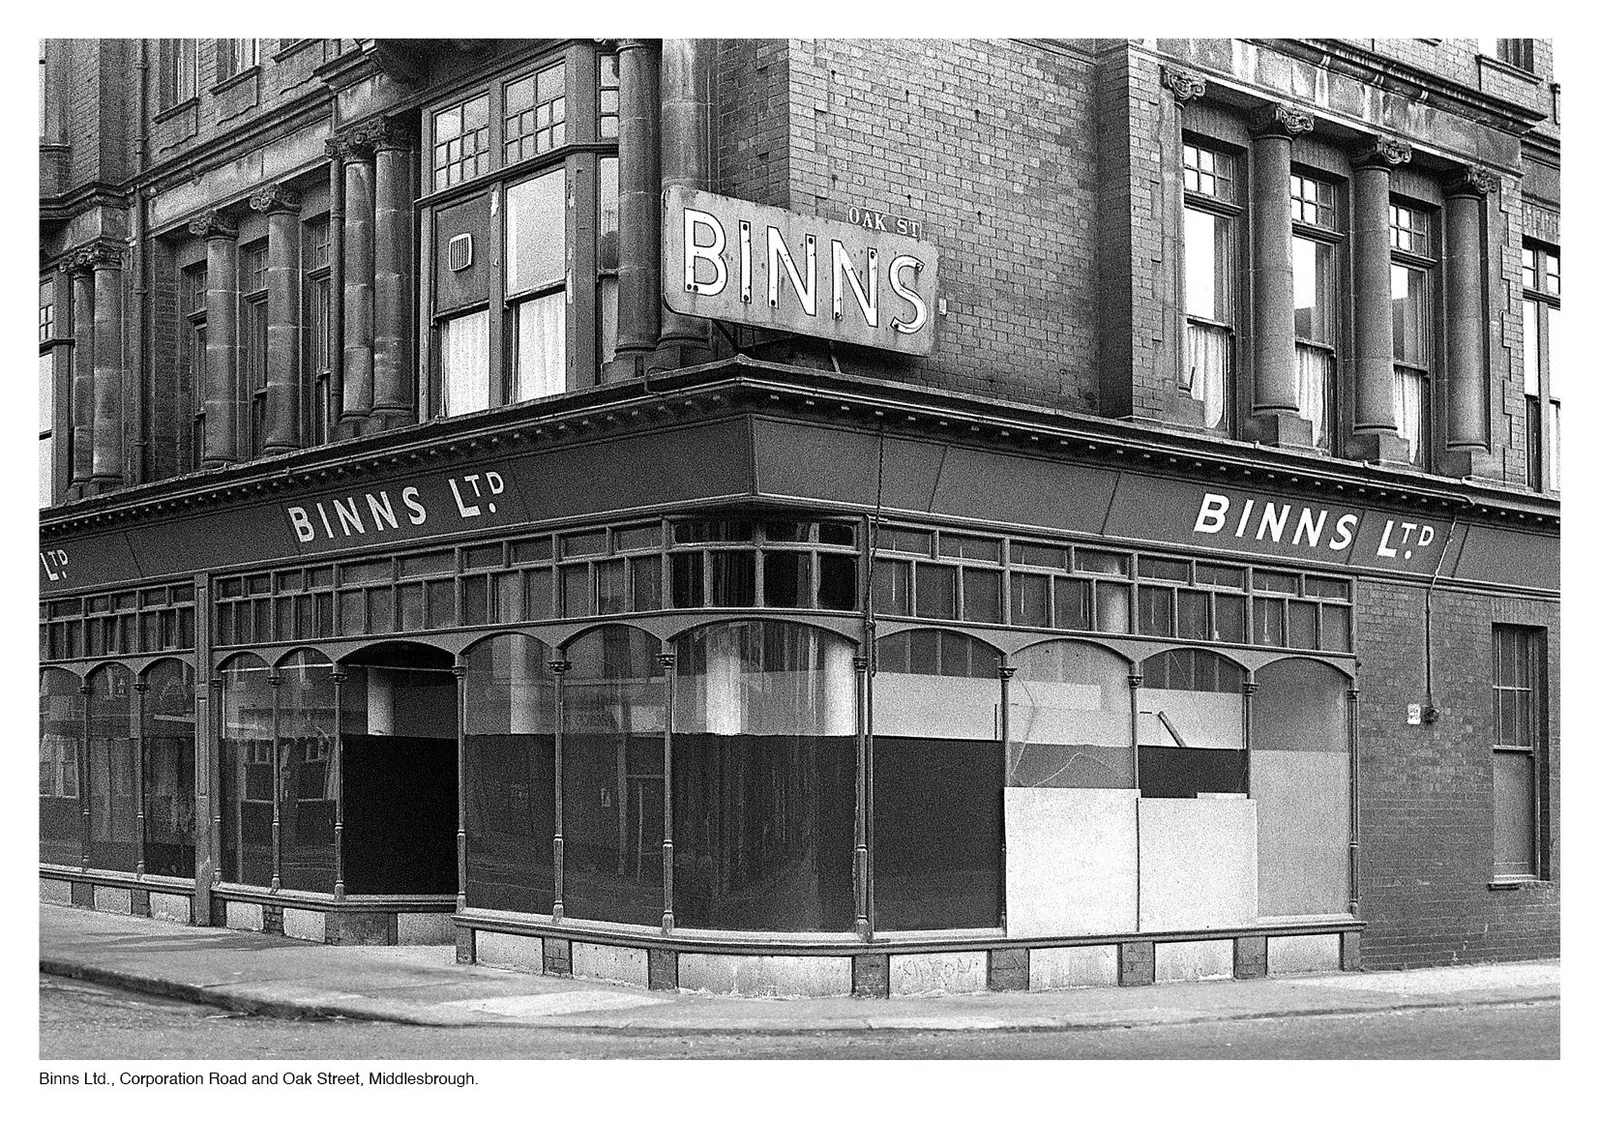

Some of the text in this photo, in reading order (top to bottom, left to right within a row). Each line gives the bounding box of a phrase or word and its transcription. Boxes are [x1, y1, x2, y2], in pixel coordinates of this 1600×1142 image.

[848, 206, 920, 238] OAK ST
[683, 207, 928, 335] BINNS
[288, 486, 427, 543] BINNS
[1193, 492, 1358, 551] BINNS
